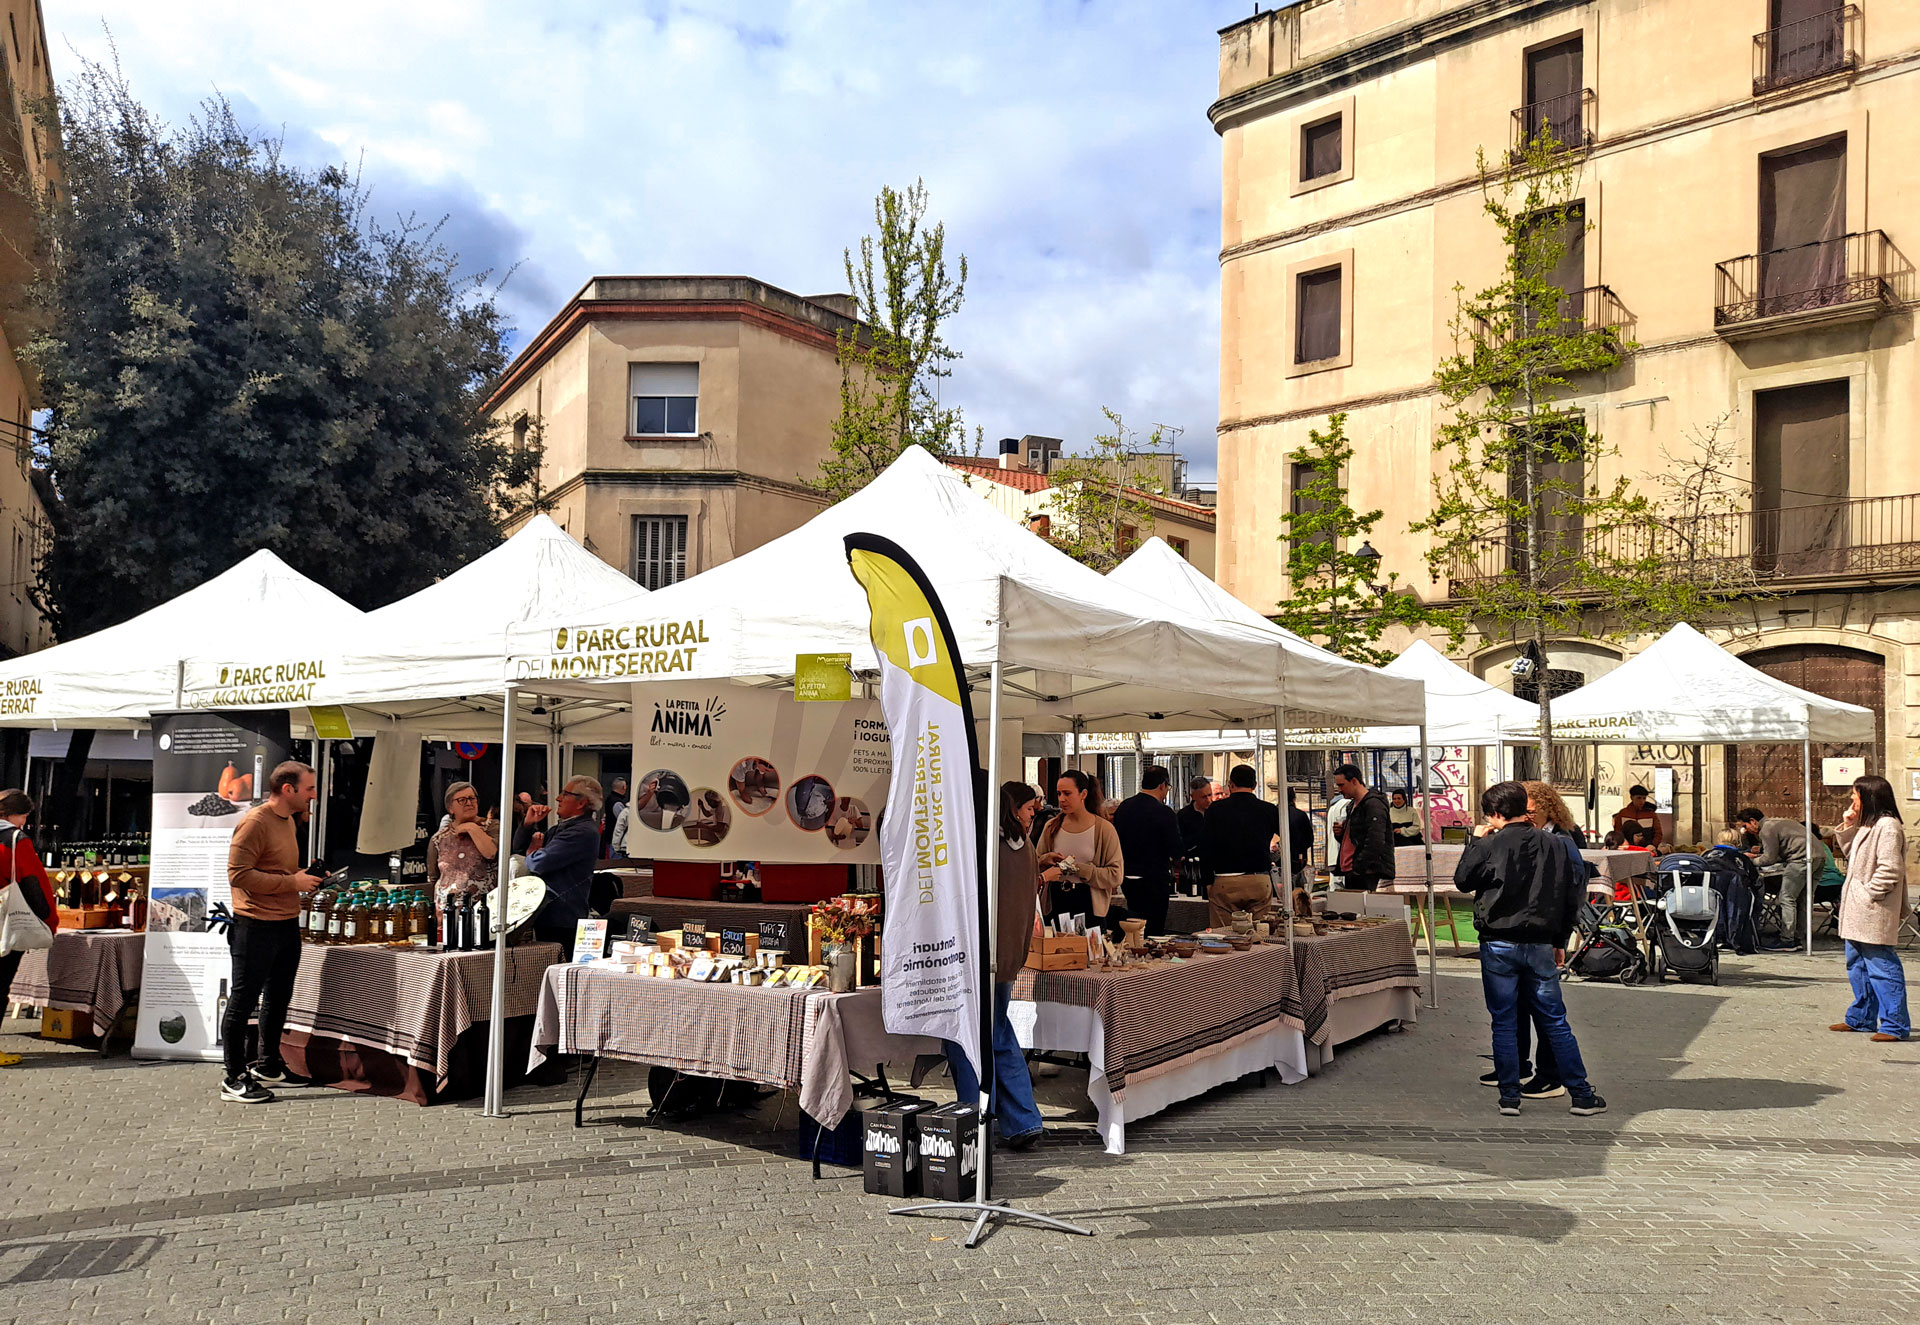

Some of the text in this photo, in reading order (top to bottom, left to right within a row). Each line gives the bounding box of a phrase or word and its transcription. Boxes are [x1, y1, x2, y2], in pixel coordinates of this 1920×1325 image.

[576, 620, 709, 652] PARC RURAL
[234, 660, 326, 686] PARC RURAL
[6, 678, 43, 697] RURAL
[0, 697, 37, 715] ERRAT
[666, 699, 700, 711] LA PETITA
[1588, 715, 1637, 728] RURAL
[1330, 726, 1367, 734] RURAL
[1533, 728, 1628, 739] NTSERRAT
[1096, 731, 1152, 742] PARC RUAL
[1085, 742, 1145, 751] MONTSERRT
[853, 749, 869, 757] FETS
